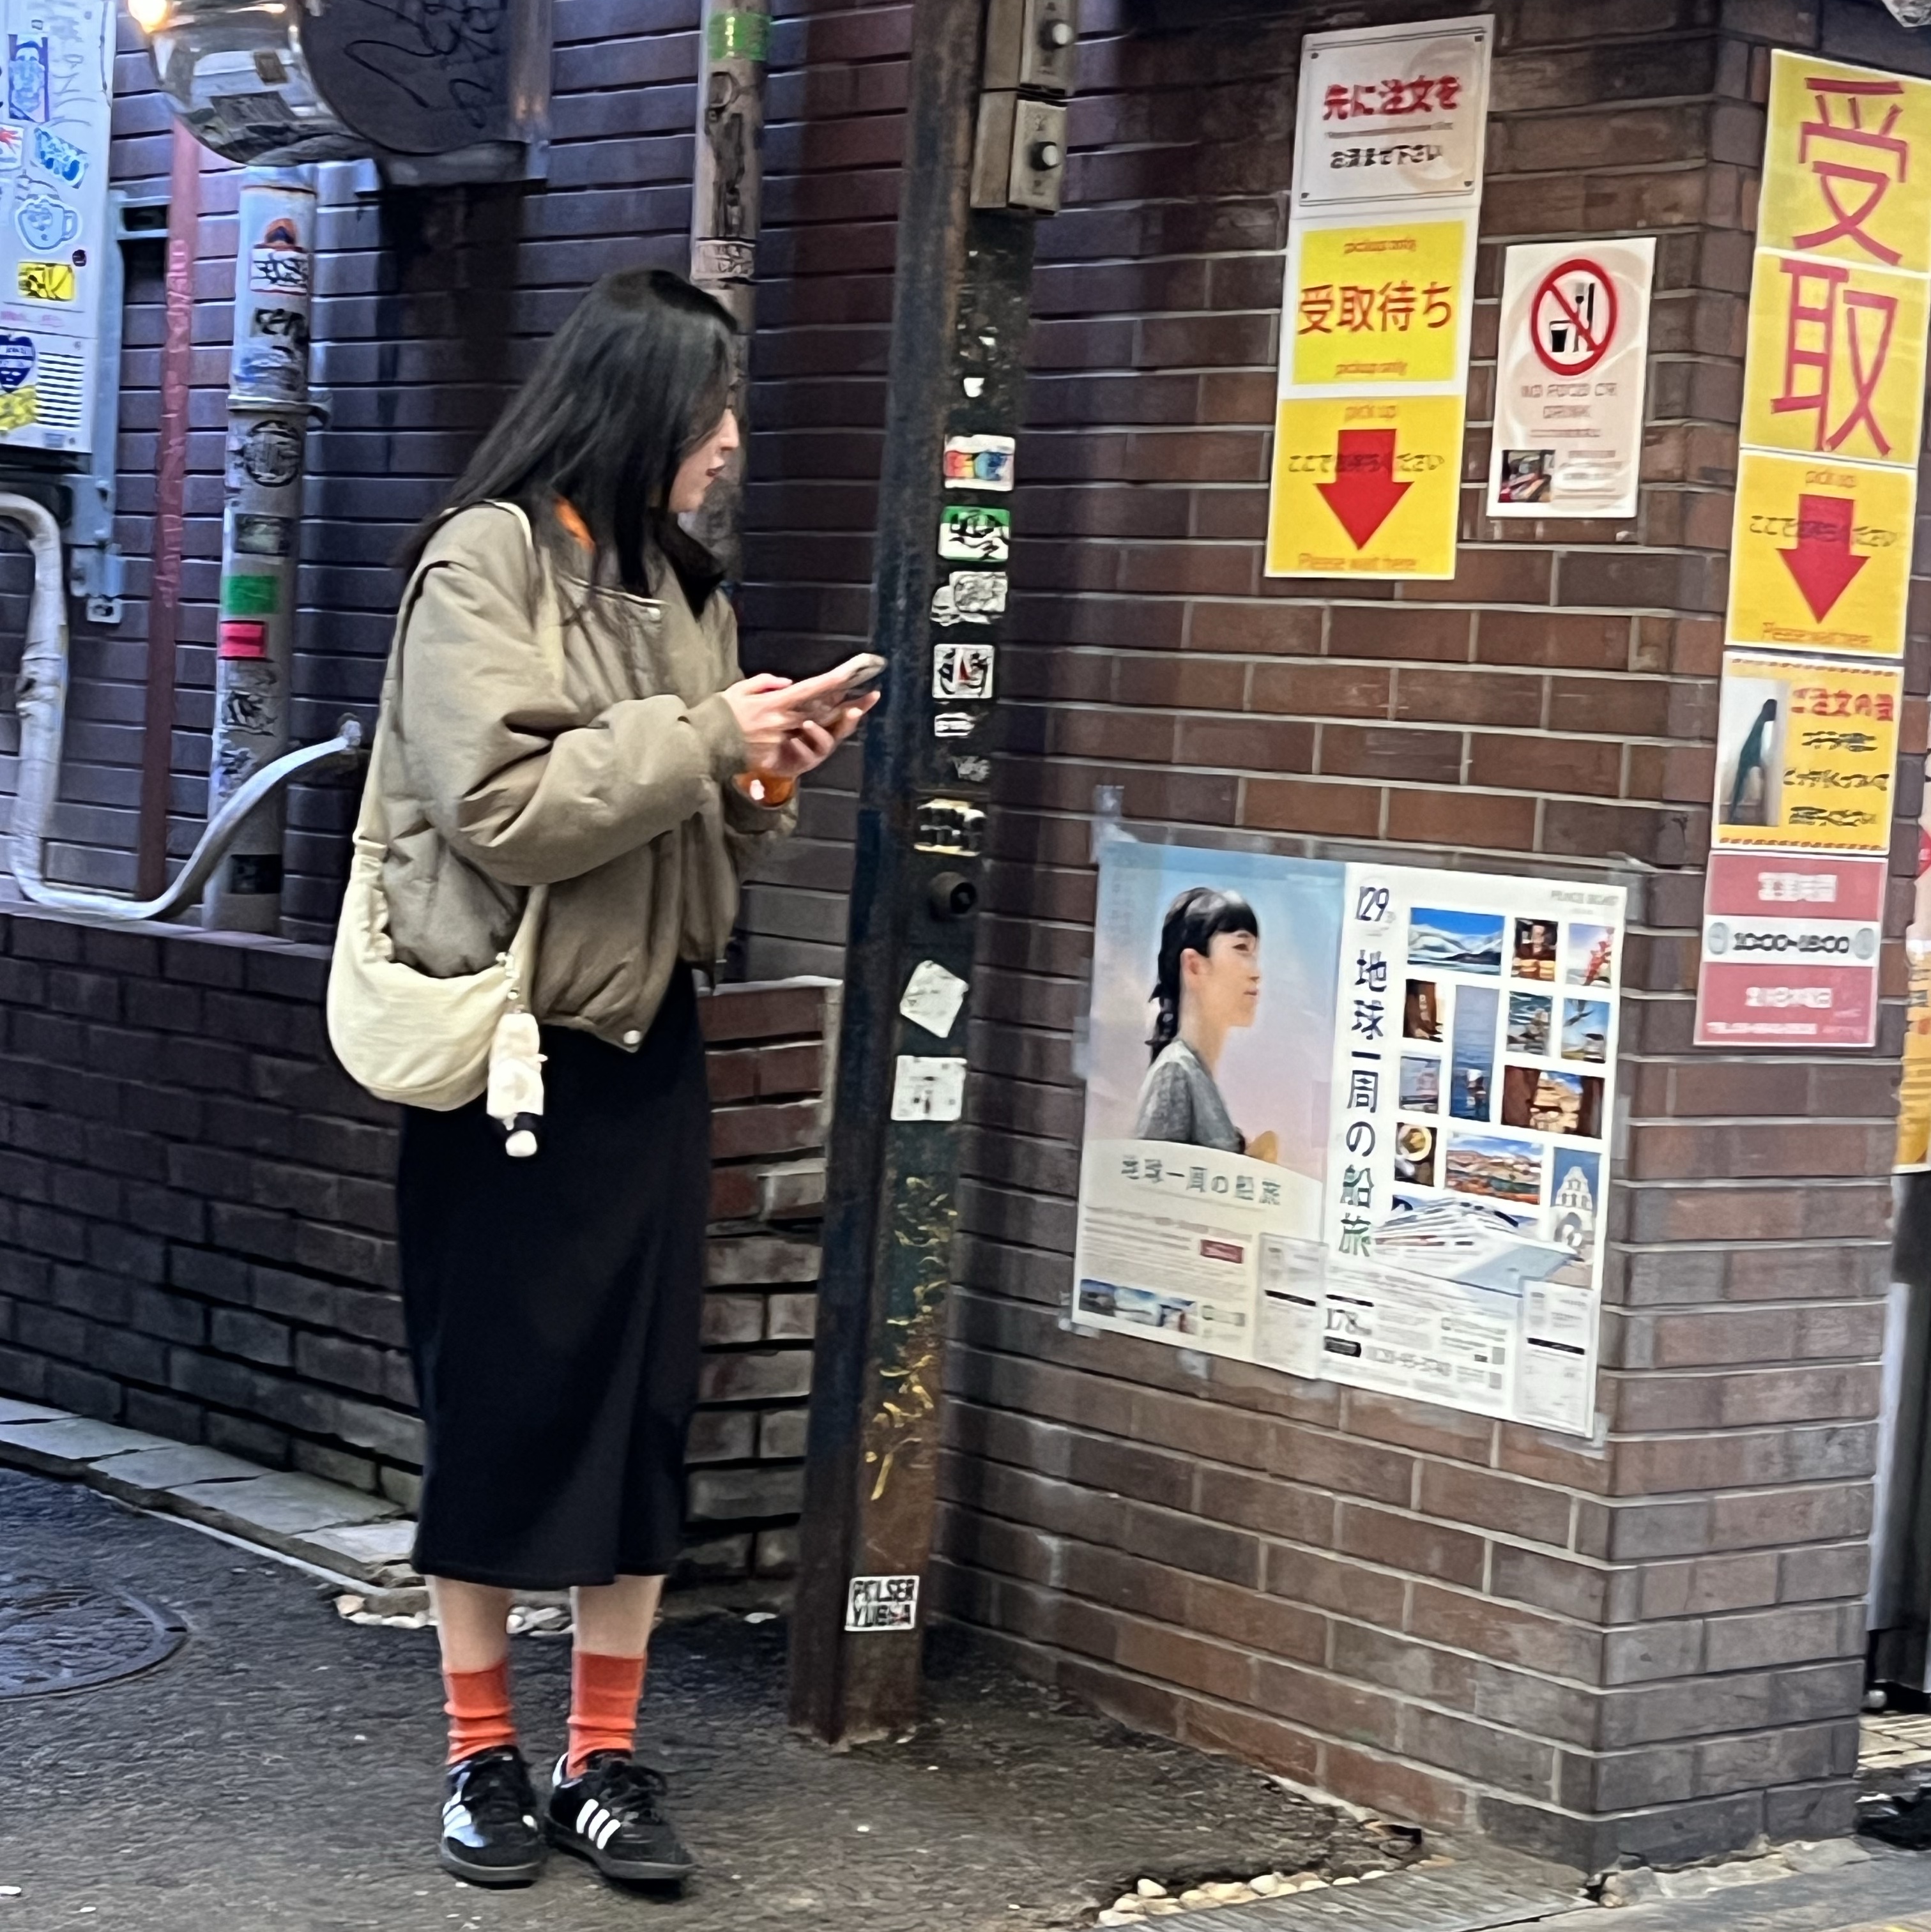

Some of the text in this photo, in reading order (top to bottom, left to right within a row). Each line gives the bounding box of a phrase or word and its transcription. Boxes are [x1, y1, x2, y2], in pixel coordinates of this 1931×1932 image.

[1297, 280, 1453, 335] 受取待ち
[1339, 949, 1387, 1257] 地球一周の船旅
